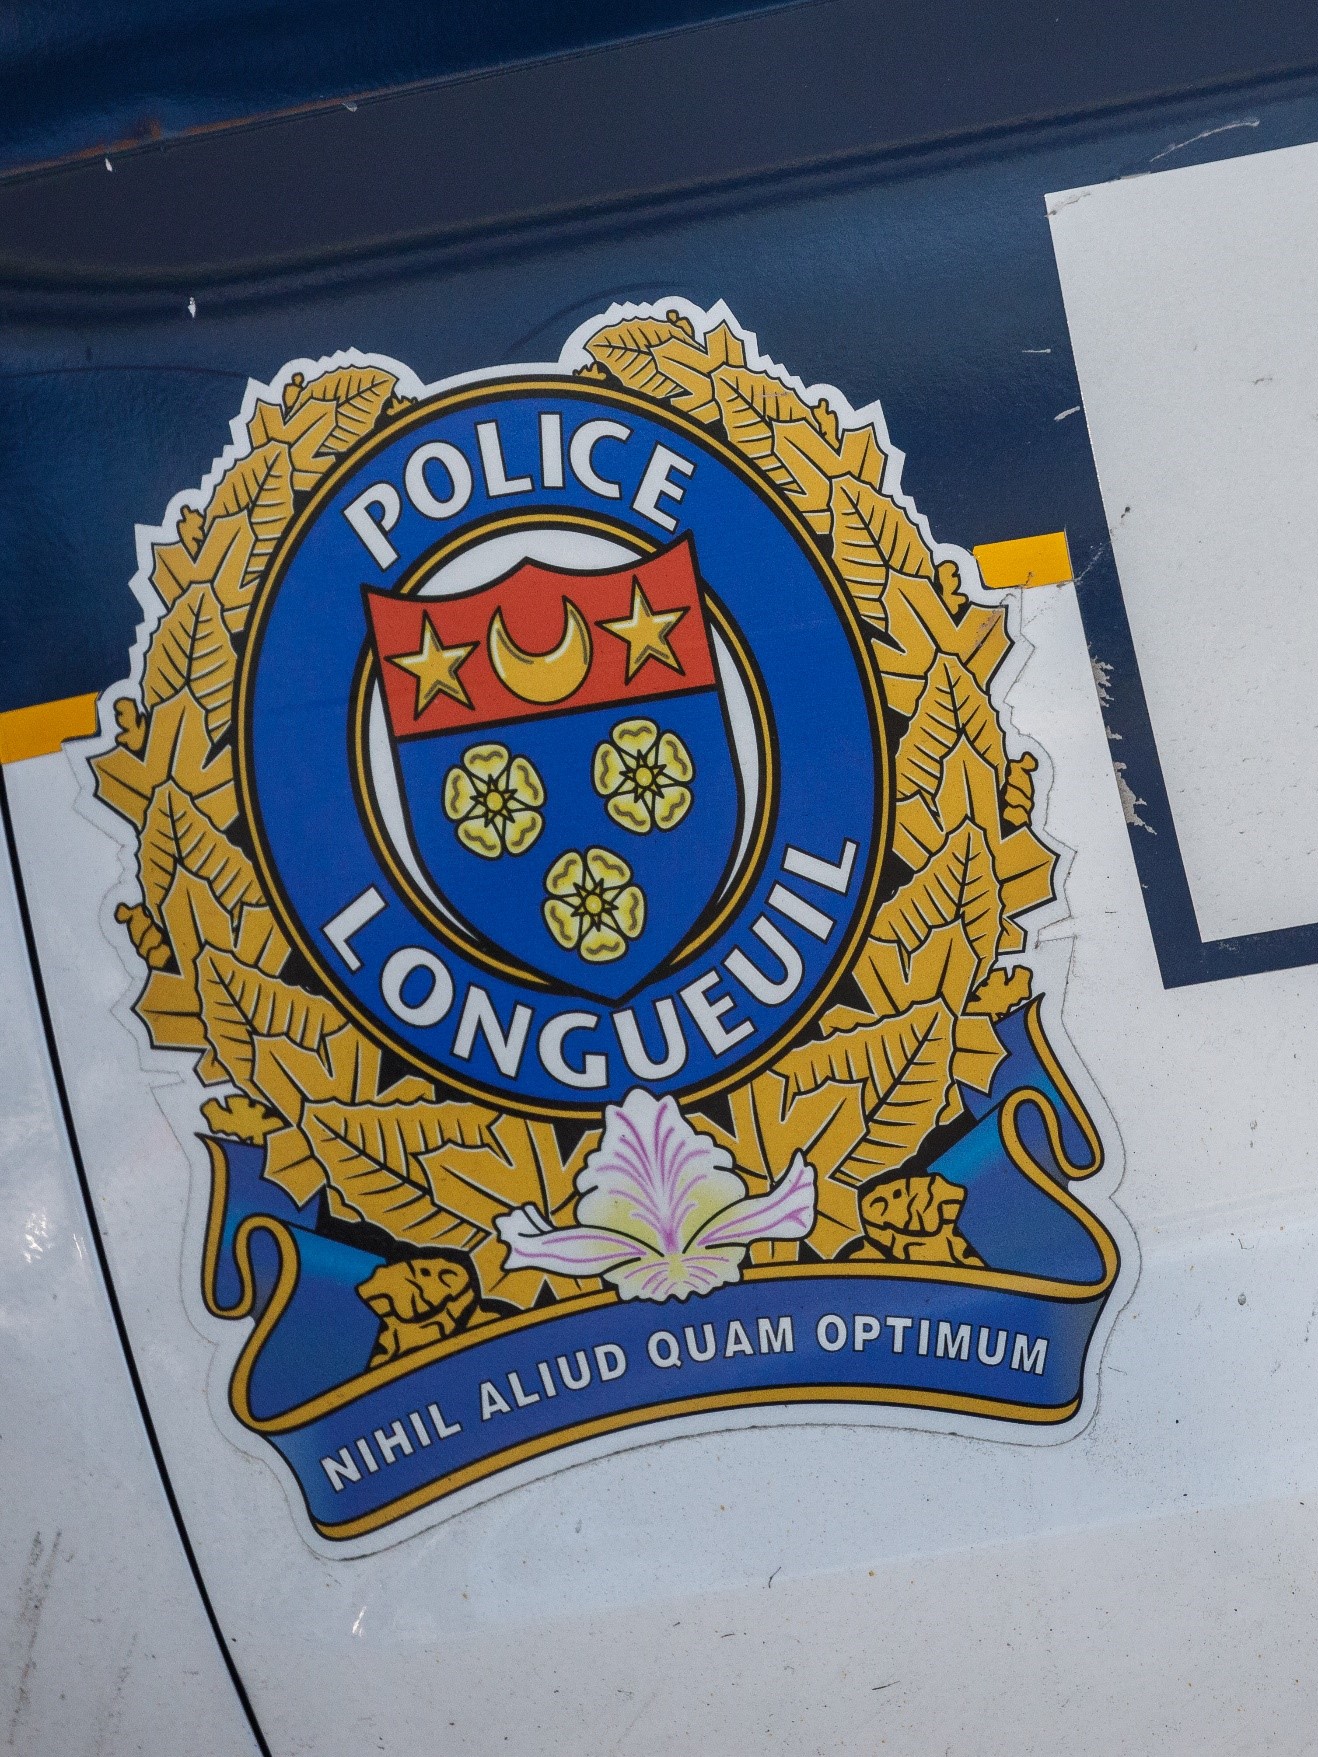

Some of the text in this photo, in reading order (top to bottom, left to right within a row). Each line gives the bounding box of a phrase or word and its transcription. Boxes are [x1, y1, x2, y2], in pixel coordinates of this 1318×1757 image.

[342, 411, 697, 572] POLICE
[321, 836, 861, 1089] LONGUEUIL
[320, 1313, 1050, 1494] NIHIL ALIUD QUAM OPTIMUM
